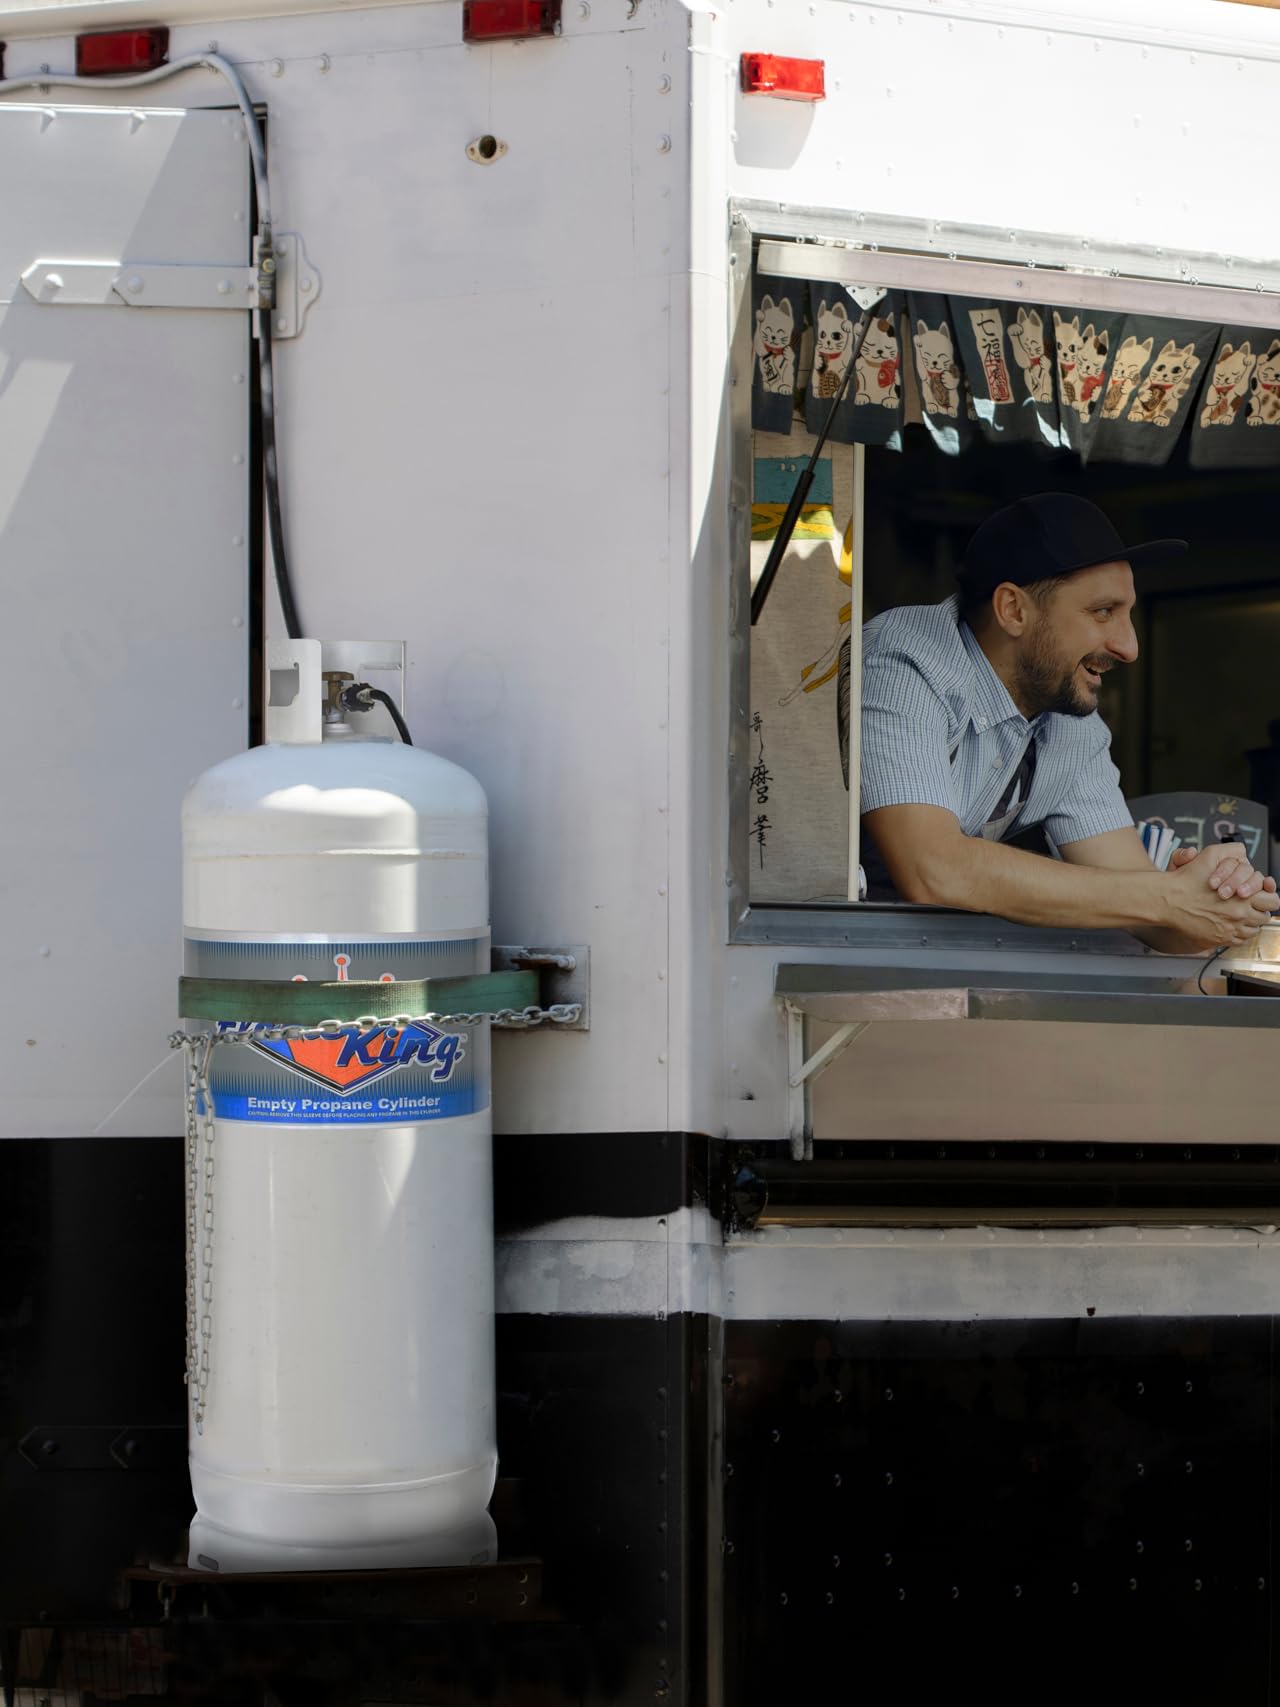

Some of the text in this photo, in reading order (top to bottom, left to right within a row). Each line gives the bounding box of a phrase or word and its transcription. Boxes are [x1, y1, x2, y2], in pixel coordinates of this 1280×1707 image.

[336, 1027, 462, 1078] King
[248, 1096, 441, 1112] Empty Propane Cylinder
